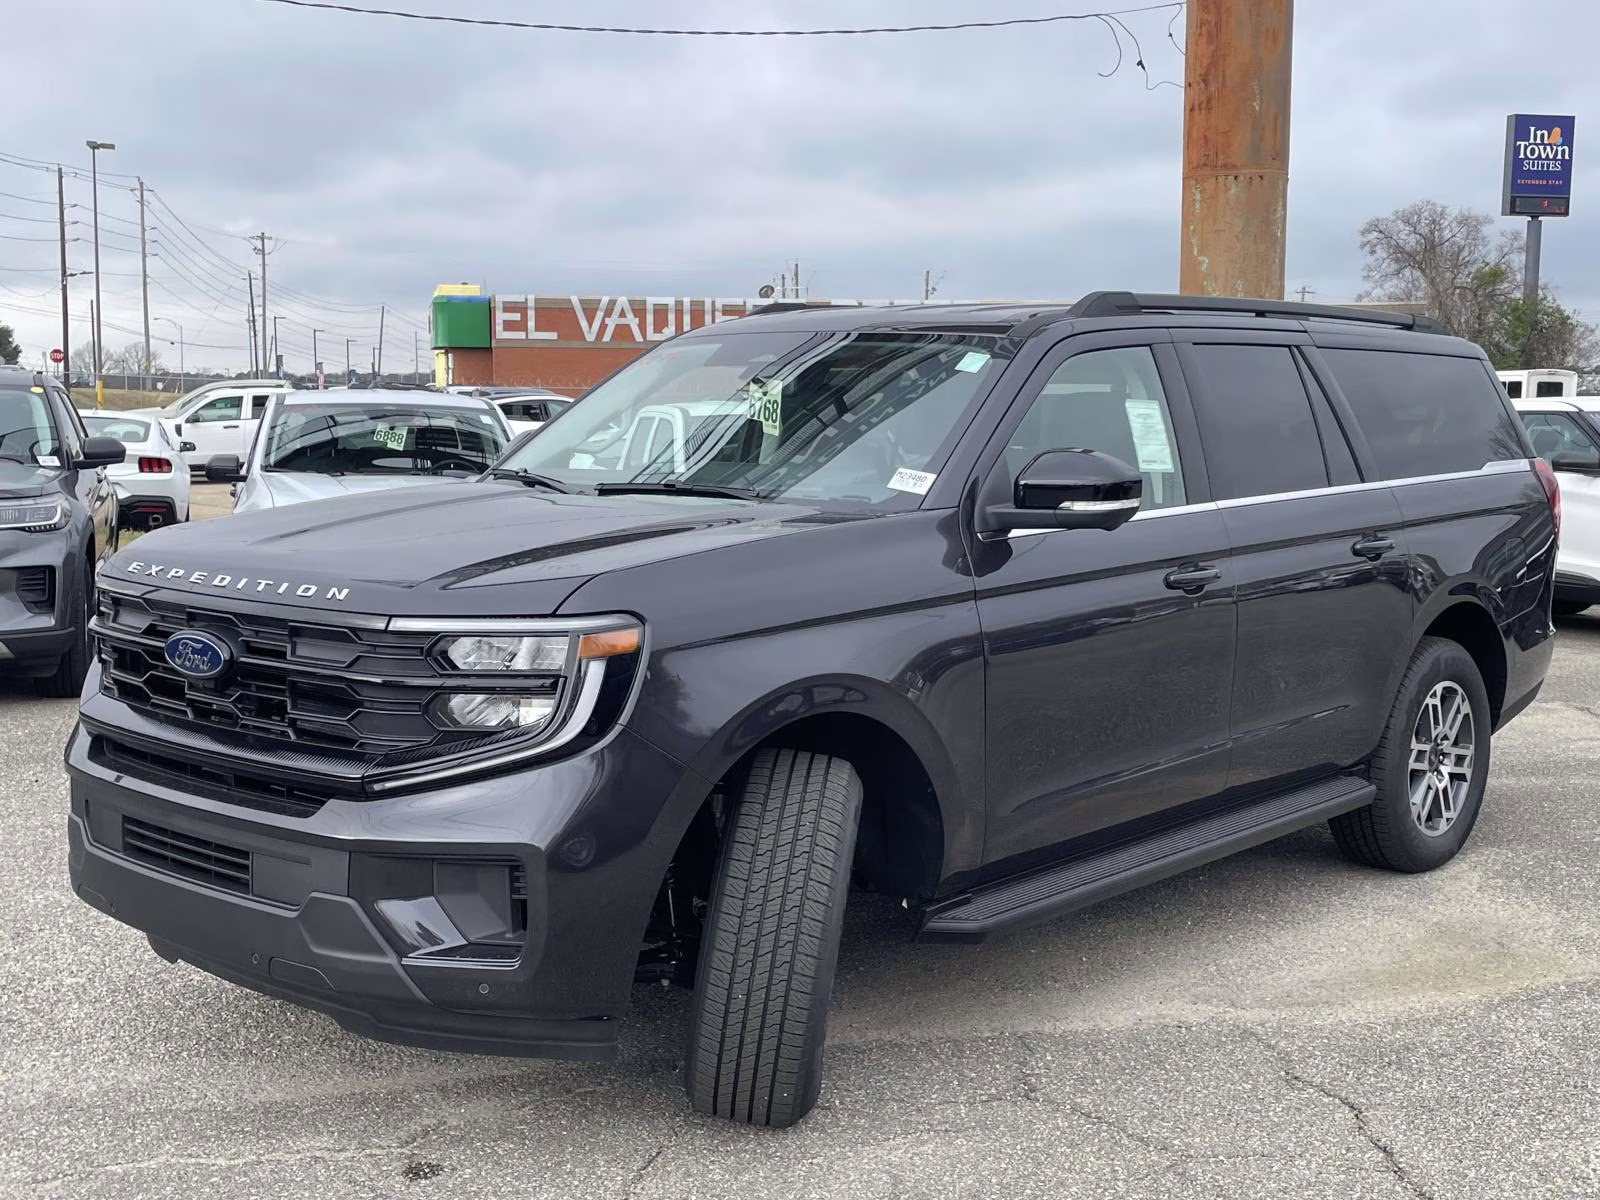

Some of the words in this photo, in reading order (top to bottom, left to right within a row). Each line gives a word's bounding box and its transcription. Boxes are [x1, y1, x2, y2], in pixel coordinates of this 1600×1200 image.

[1529, 126, 1549, 144] In
[1516, 141, 1570, 160] Town
[1523, 160, 1562, 171] SUITES
[495, 295, 558, 340] EL
[376, 429, 404, 445] 6888
[127, 561, 350, 601] EXPEDITION
[174, 639, 212, 672] Ford
